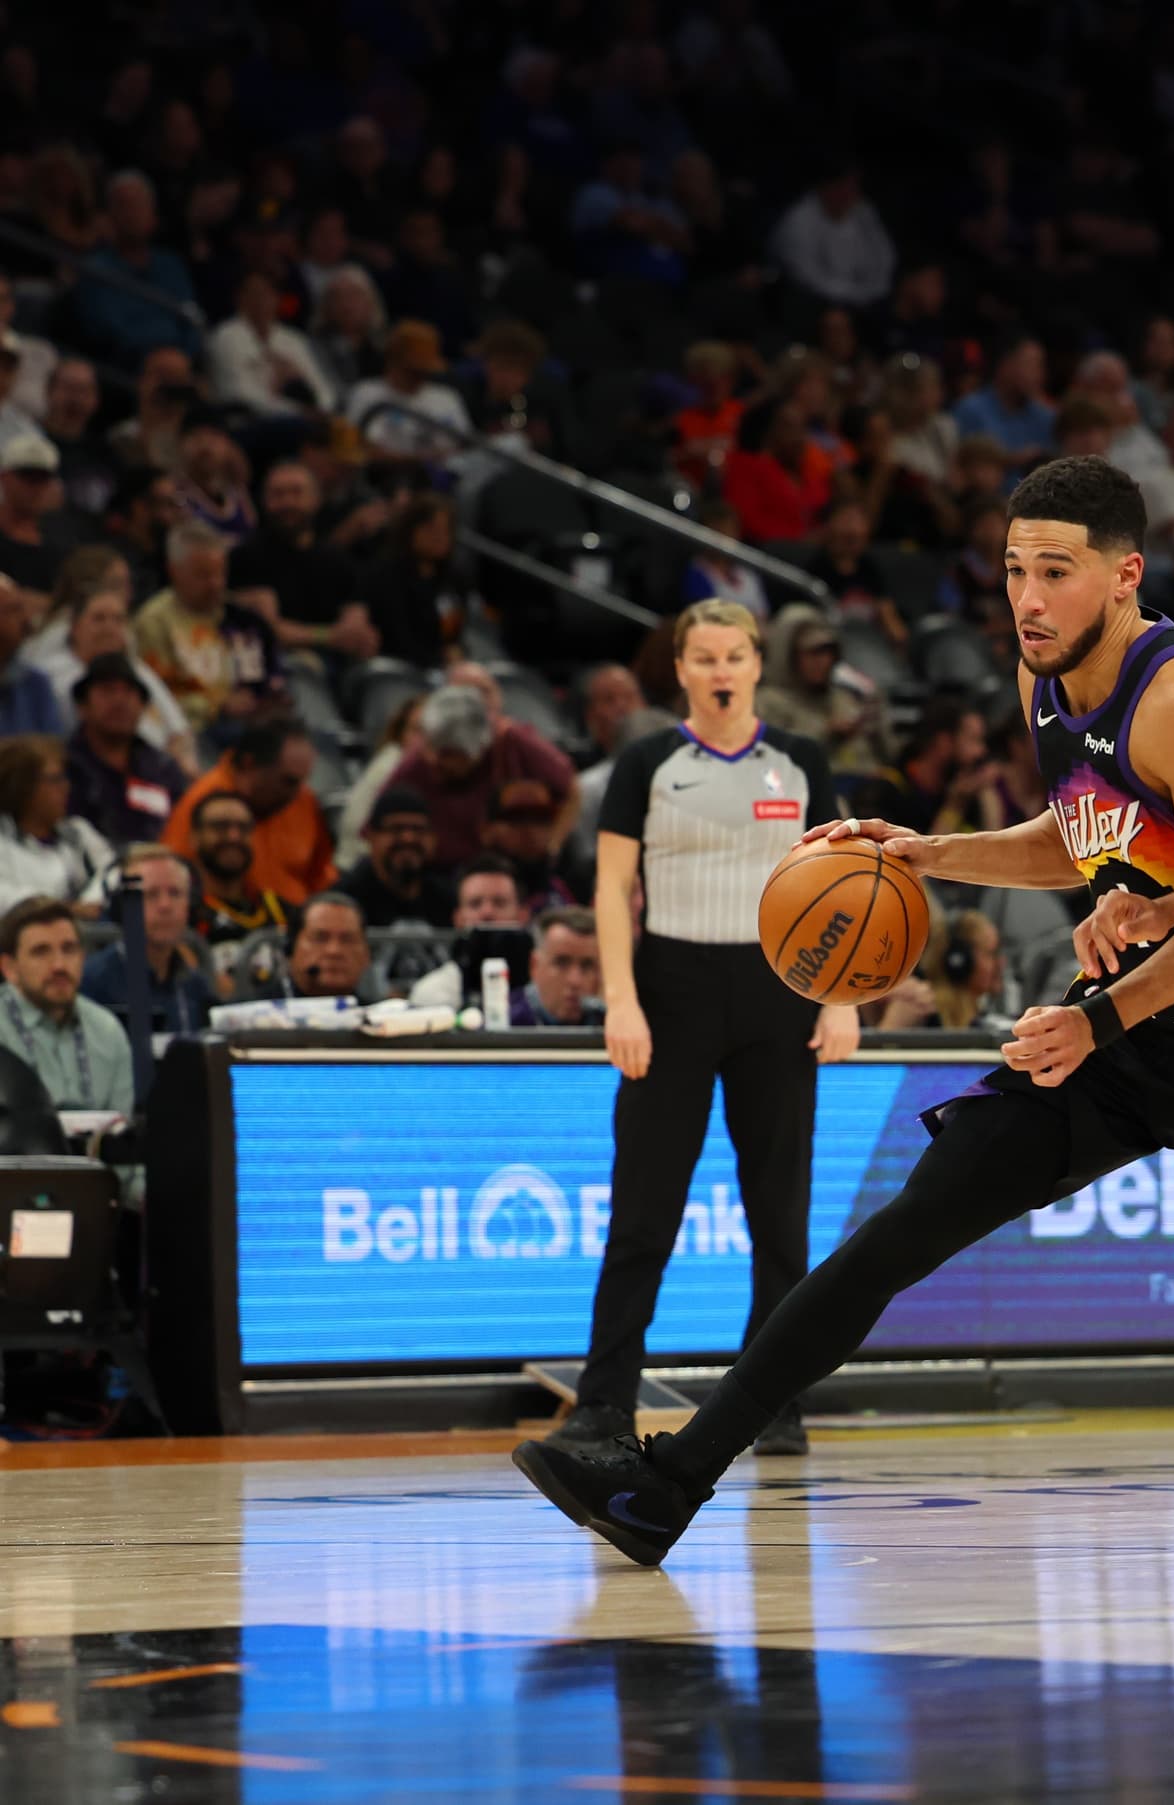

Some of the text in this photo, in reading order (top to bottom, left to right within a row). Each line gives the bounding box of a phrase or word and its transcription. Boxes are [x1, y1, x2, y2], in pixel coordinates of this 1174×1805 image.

[1085, 733, 1115, 755] PayPal
[1048, 792, 1145, 865] Valley
[1064, 804, 1077, 818] THE
[785, 911, 855, 993] Wilson
[323, 1185, 754, 1262] Bell Bnk
